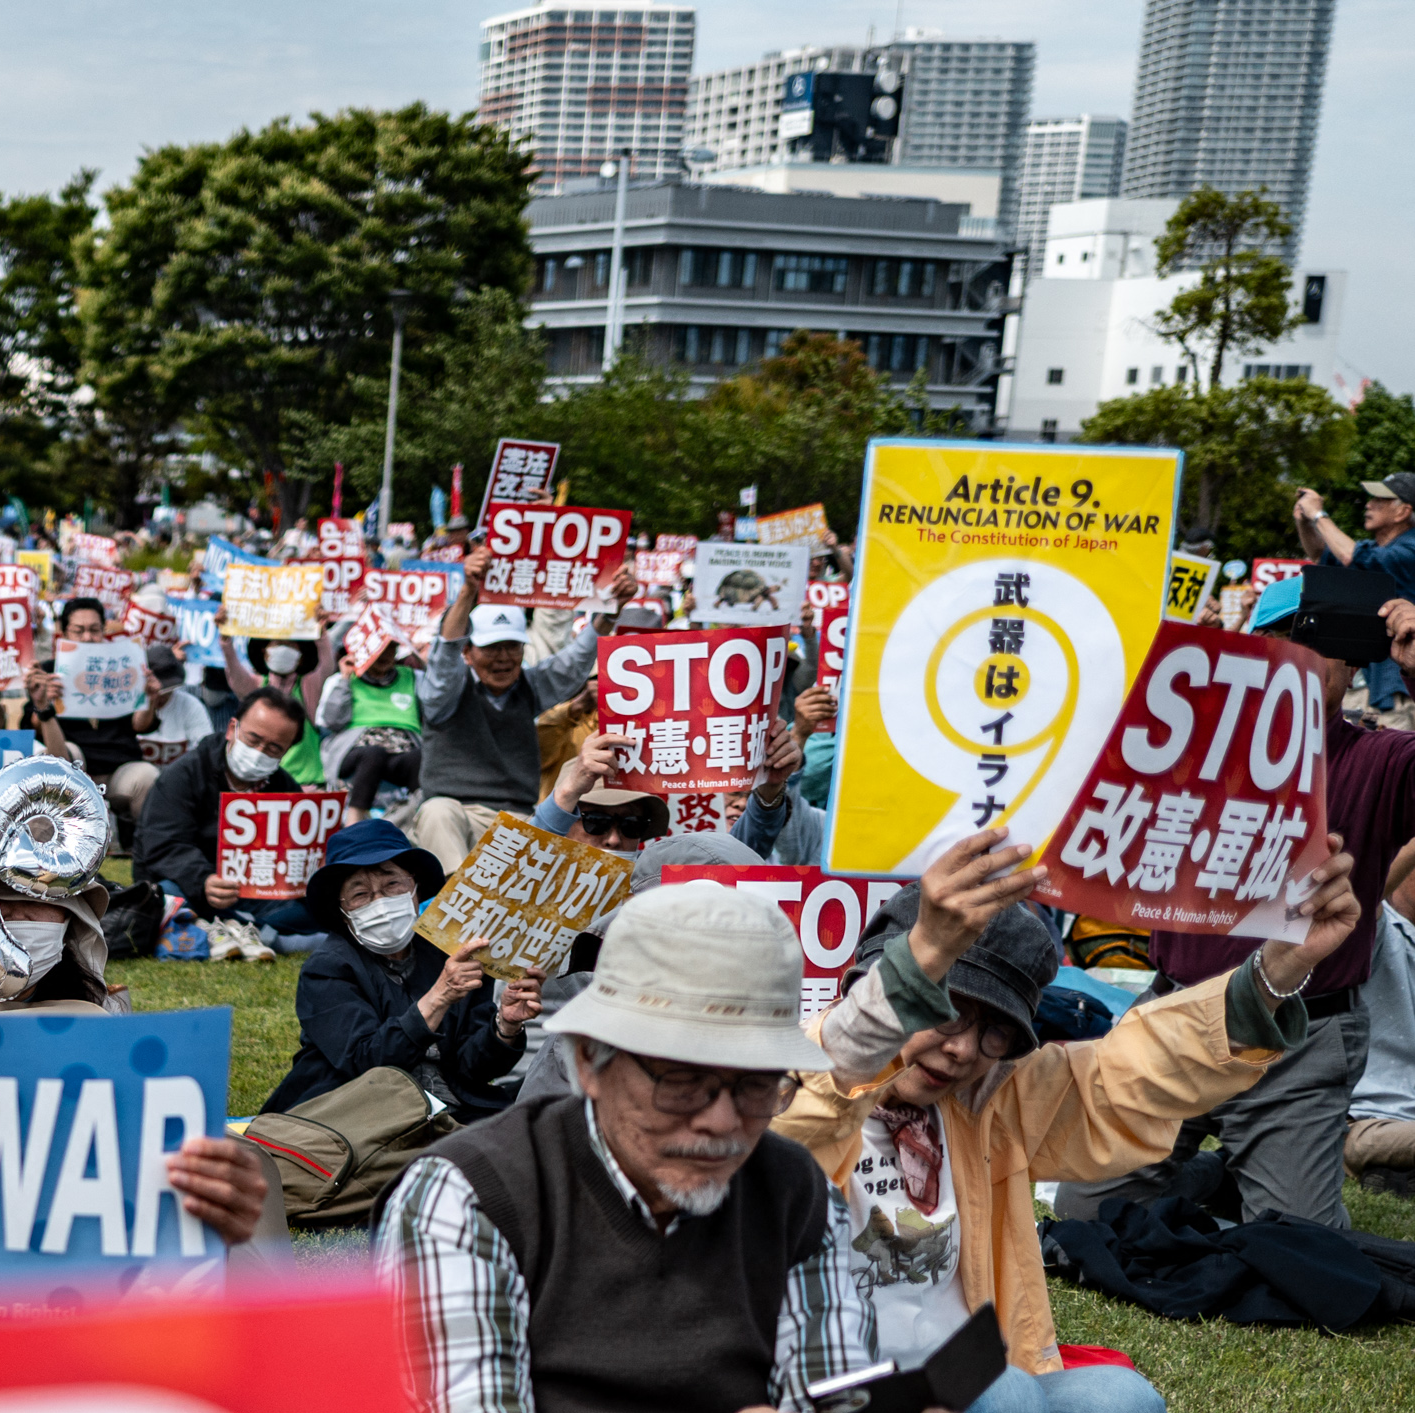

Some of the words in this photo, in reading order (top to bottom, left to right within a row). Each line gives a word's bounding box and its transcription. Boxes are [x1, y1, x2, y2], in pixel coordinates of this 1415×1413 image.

[499, 446, 550, 476] 憲法
[944, 474, 1061, 508] Article
[1070, 479, 1101, 509] 9.
[490, 508, 623, 559] STOP
[877, 503, 1061, 531] RENUNCIATION
[1065, 512, 1098, 533] OF
[1104, 514, 1160, 535] WAR
[916, 528, 946, 543] The
[950, 529, 1050, 549] Constitution
[1053, 533, 1071, 549] of
[1073, 536, 1118, 553] Japan
[206, 549, 233, 573] NO
[484, 557, 599, 599] 改憲・軍拡
[635, 552, 682, 570] STOP
[77, 566, 131, 591] STOP
[226, 568, 324, 601] 憲法いかして
[364, 571, 444, 604] STOP
[806, 584, 848, 608] OP
[182, 607, 215, 648] NO
[605, 637, 787, 716] STOP
[970, 571, 1031, 853] 武器はイラナ
[1121, 644, 1326, 793] STOP
[141, 741, 184, 762] OP
[605, 713, 771, 776] 改憲・軍拡
[662, 780, 687, 790] Peace
[688, 780, 695, 789] &
[697, 779, 729, 789] Human
[222, 798, 342, 847] STOP
[1060, 780, 1307, 903] 改憲・軍拡
[464, 825, 628, 922] 憲法いかし
[437, 881, 581, 973] 平和な世界
[1131, 903, 1161, 920] Peace
[1163, 906, 1171, 920] &
[1173, 907, 1207, 924] Human
[1207, 910, 1238, 927] Rights!
